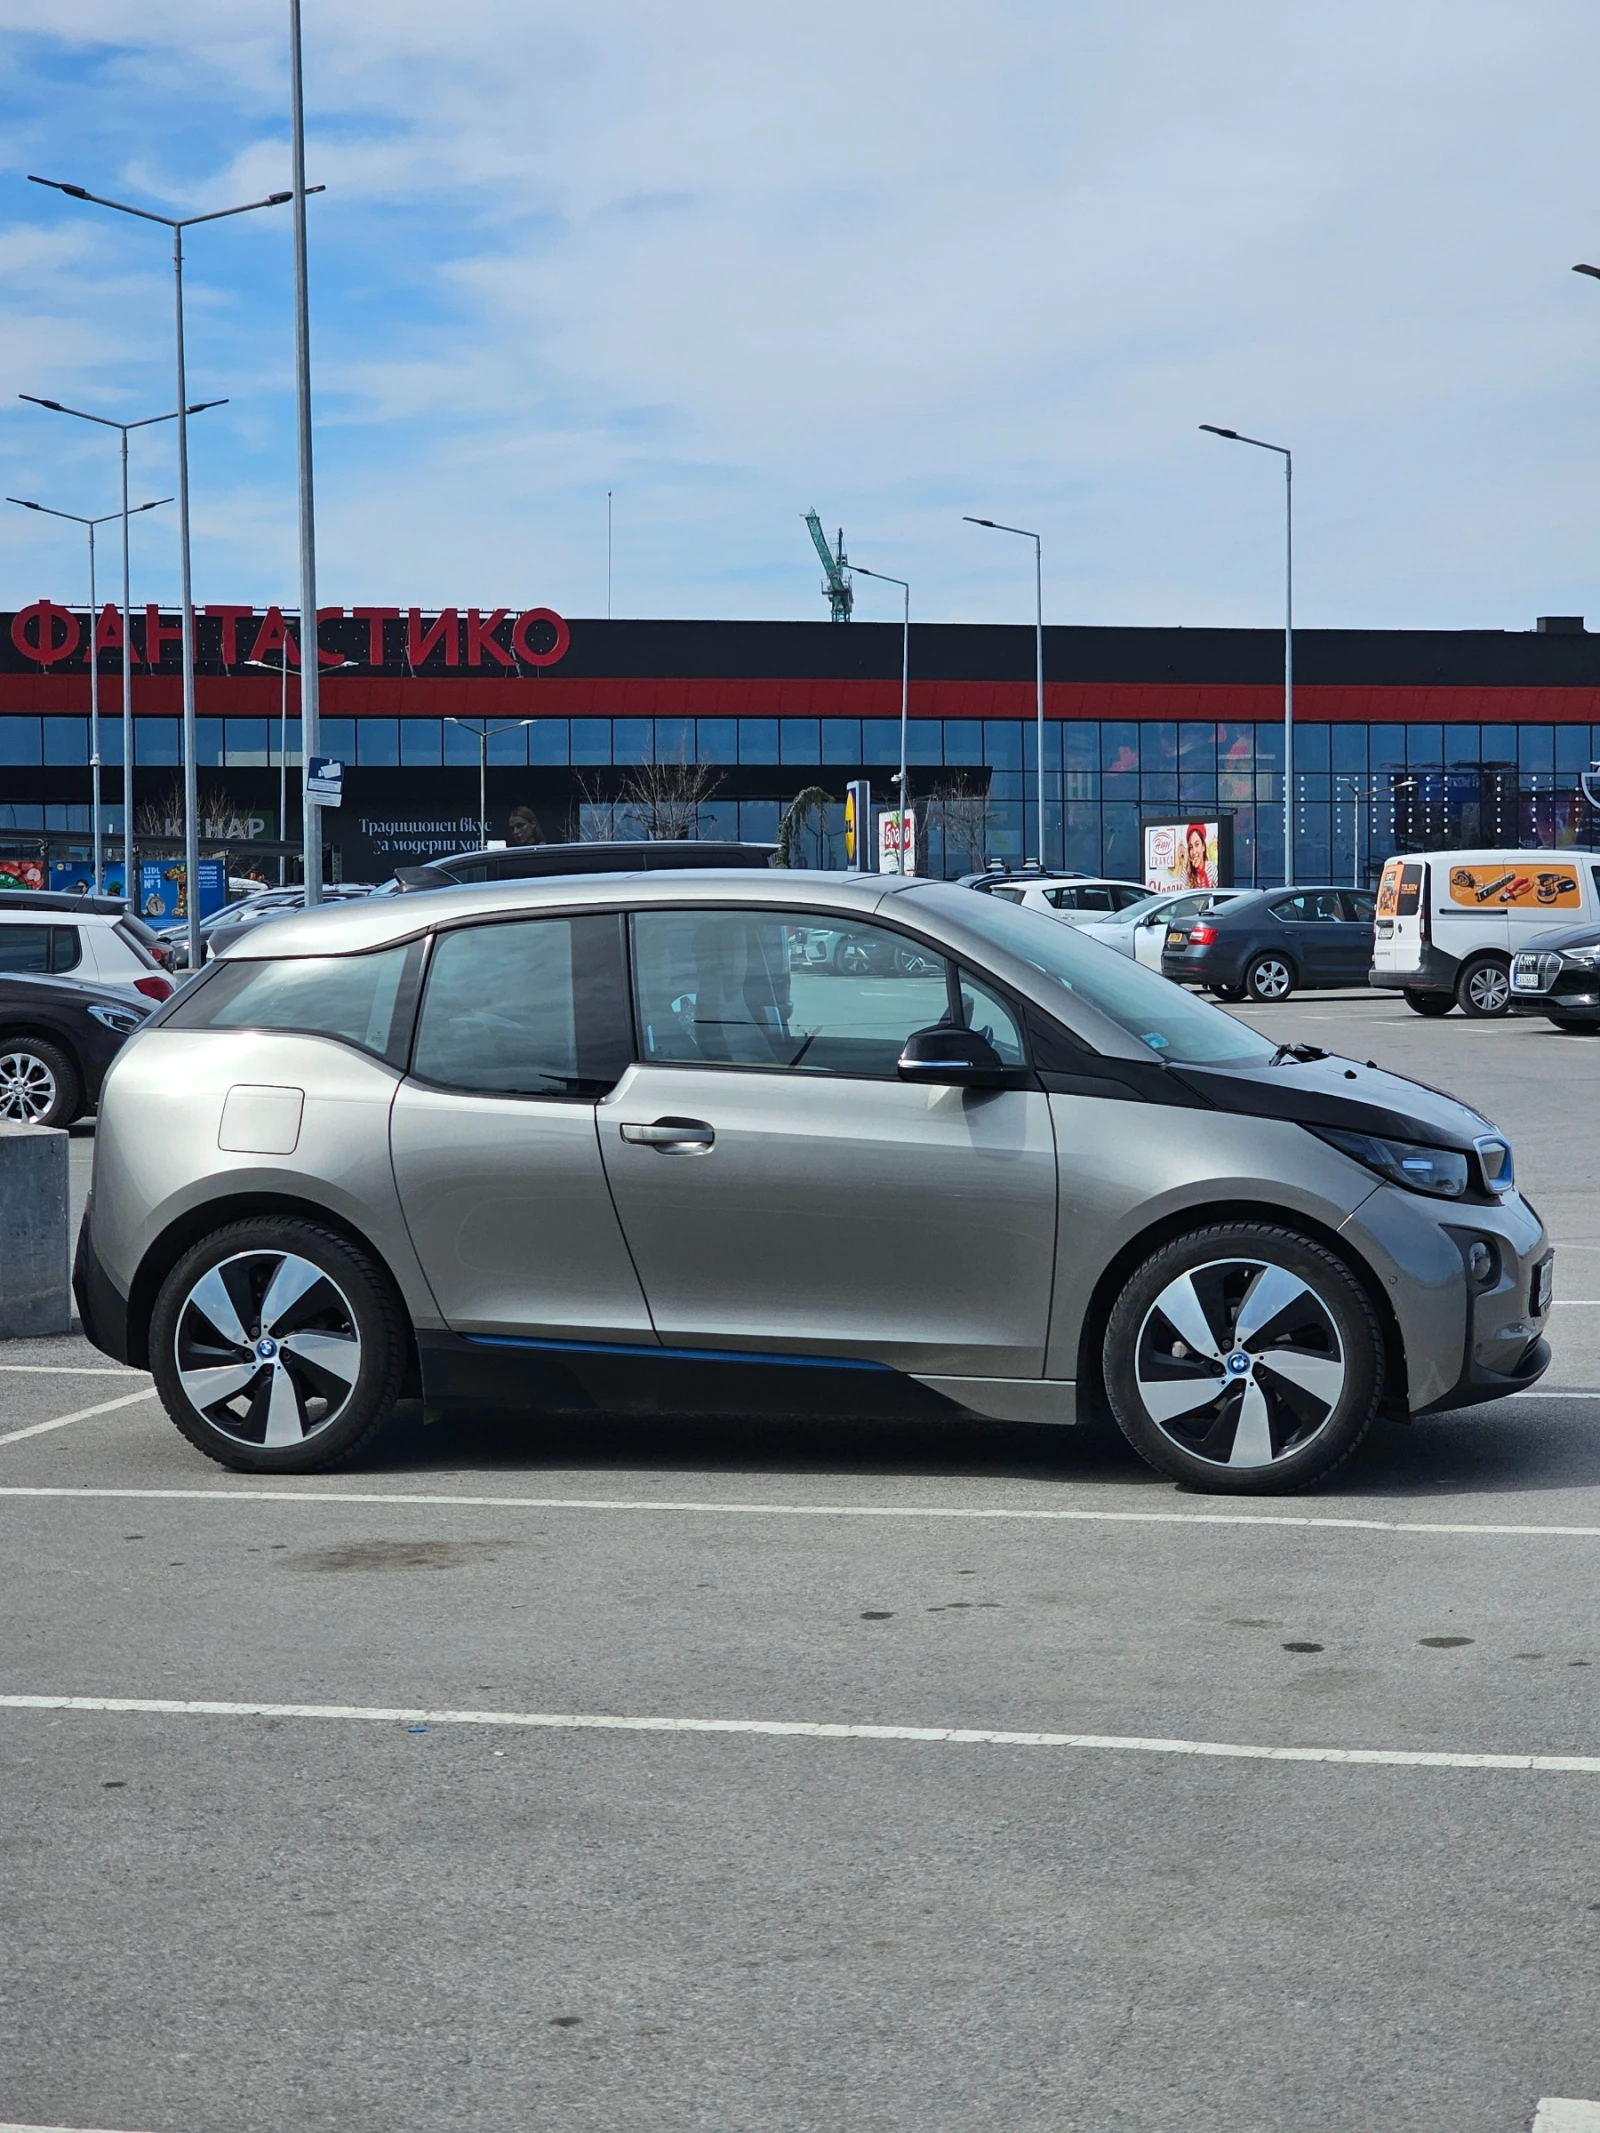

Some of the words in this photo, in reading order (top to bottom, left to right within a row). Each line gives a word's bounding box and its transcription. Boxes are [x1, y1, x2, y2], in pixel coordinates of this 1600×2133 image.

[11, 599, 571, 667] ФАНТАСТИКО
[165, 817, 265, 839] КНАР
[358, 817, 457, 836] Традиционен
[392, 840, 456, 854] модерни
[1151, 856, 1174, 866] FRANCE
[143, 867, 161, 875] LIDL
